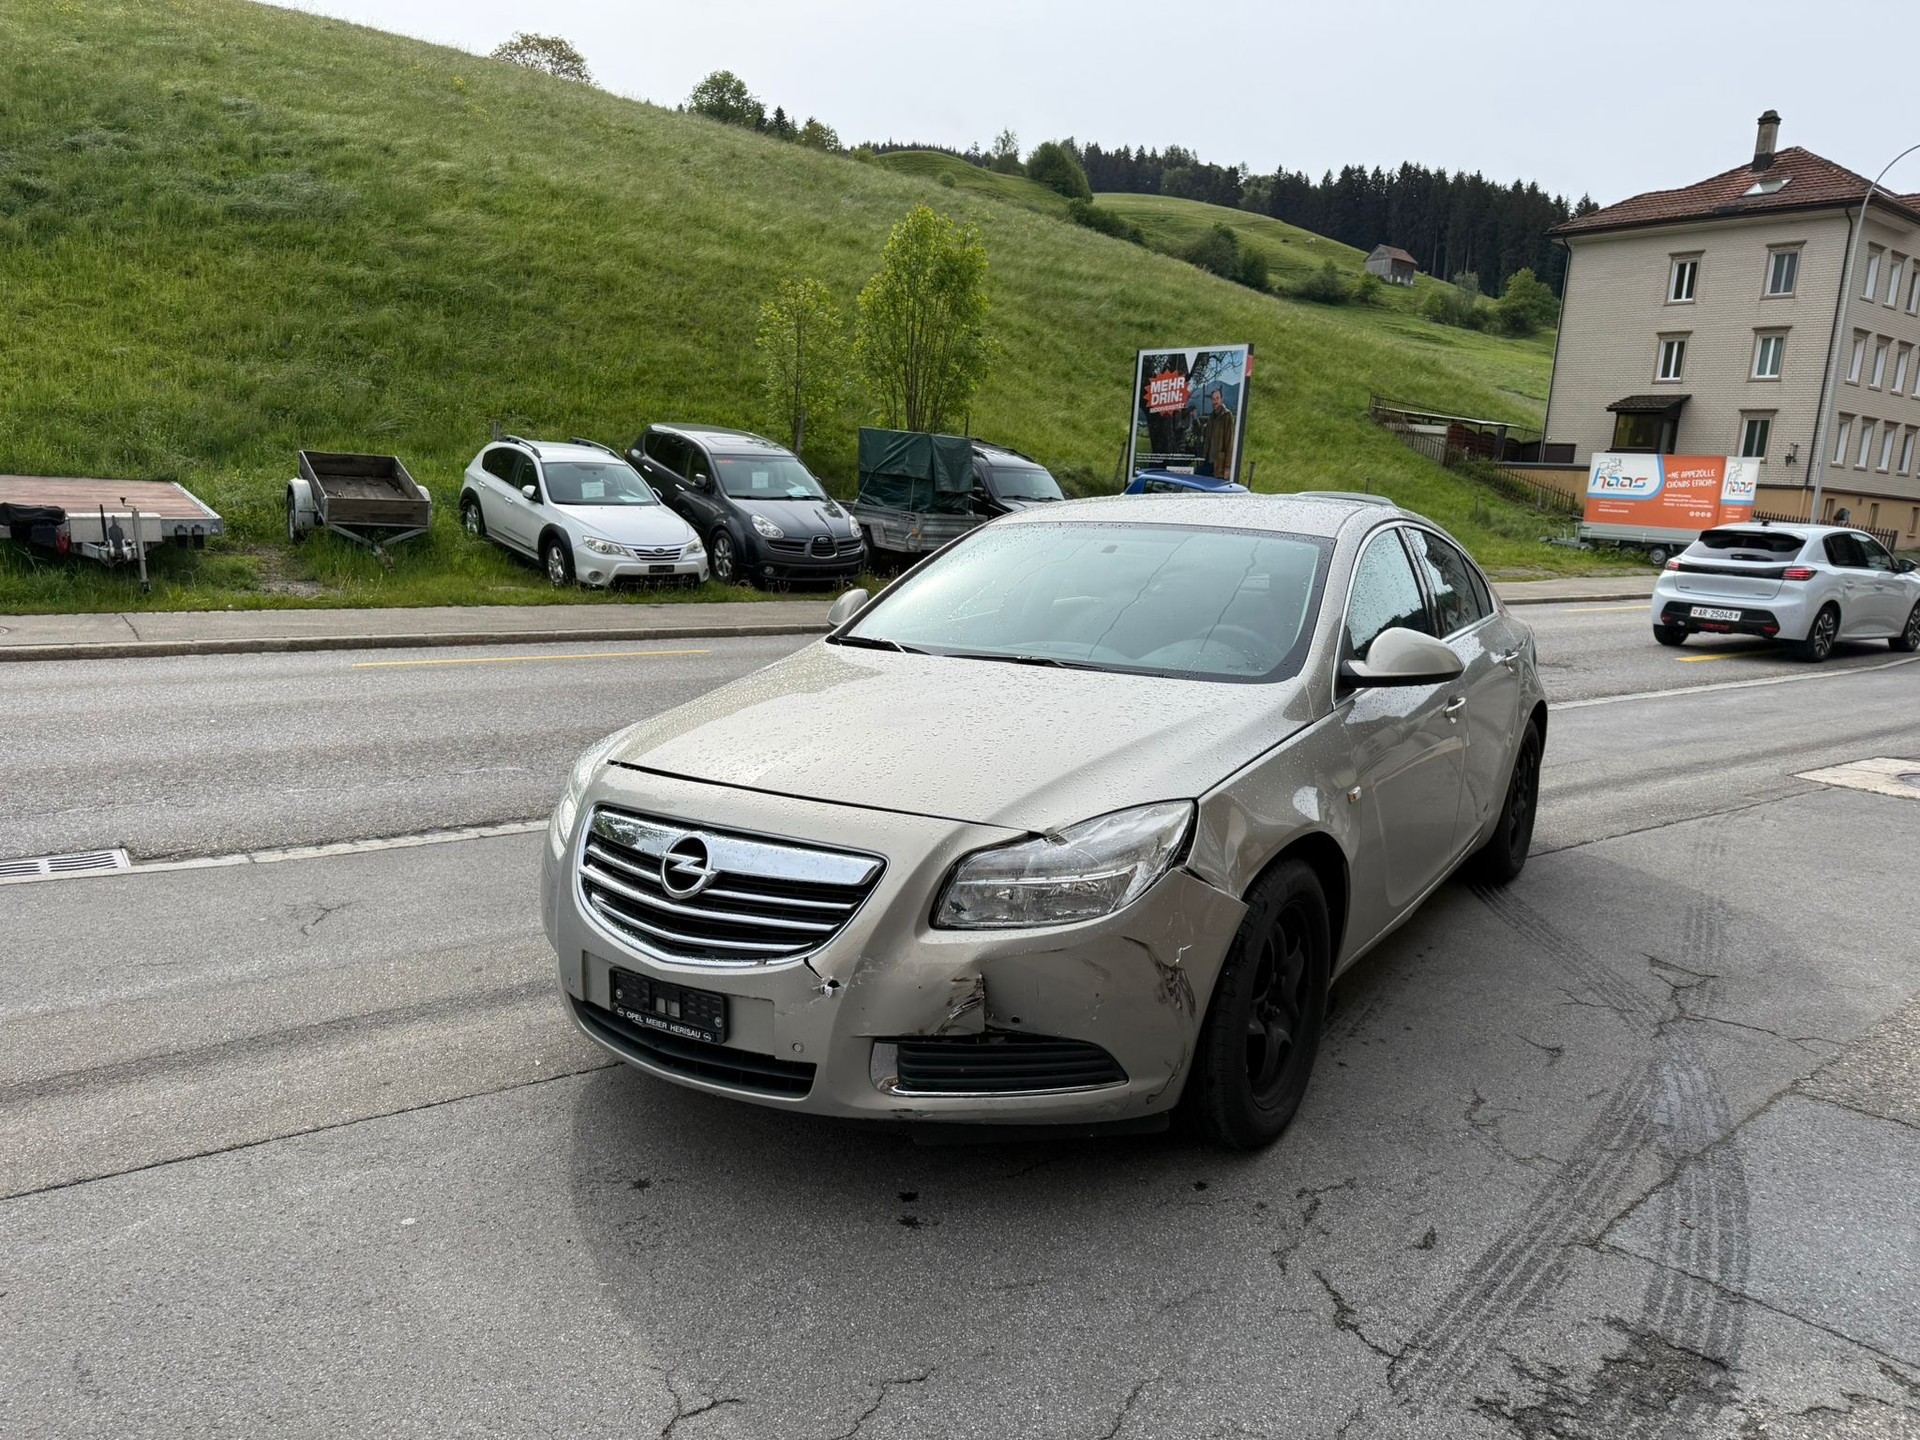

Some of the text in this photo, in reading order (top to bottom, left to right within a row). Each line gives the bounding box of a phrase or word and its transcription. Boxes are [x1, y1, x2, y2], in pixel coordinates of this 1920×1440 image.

[1151, 377, 1185, 393] MEHR
[1151, 390, 1183, 406] DRIN:
[1592, 467, 1648, 489] haas
[626, 1011, 701, 1038] OPEL MEIER HERISAU
